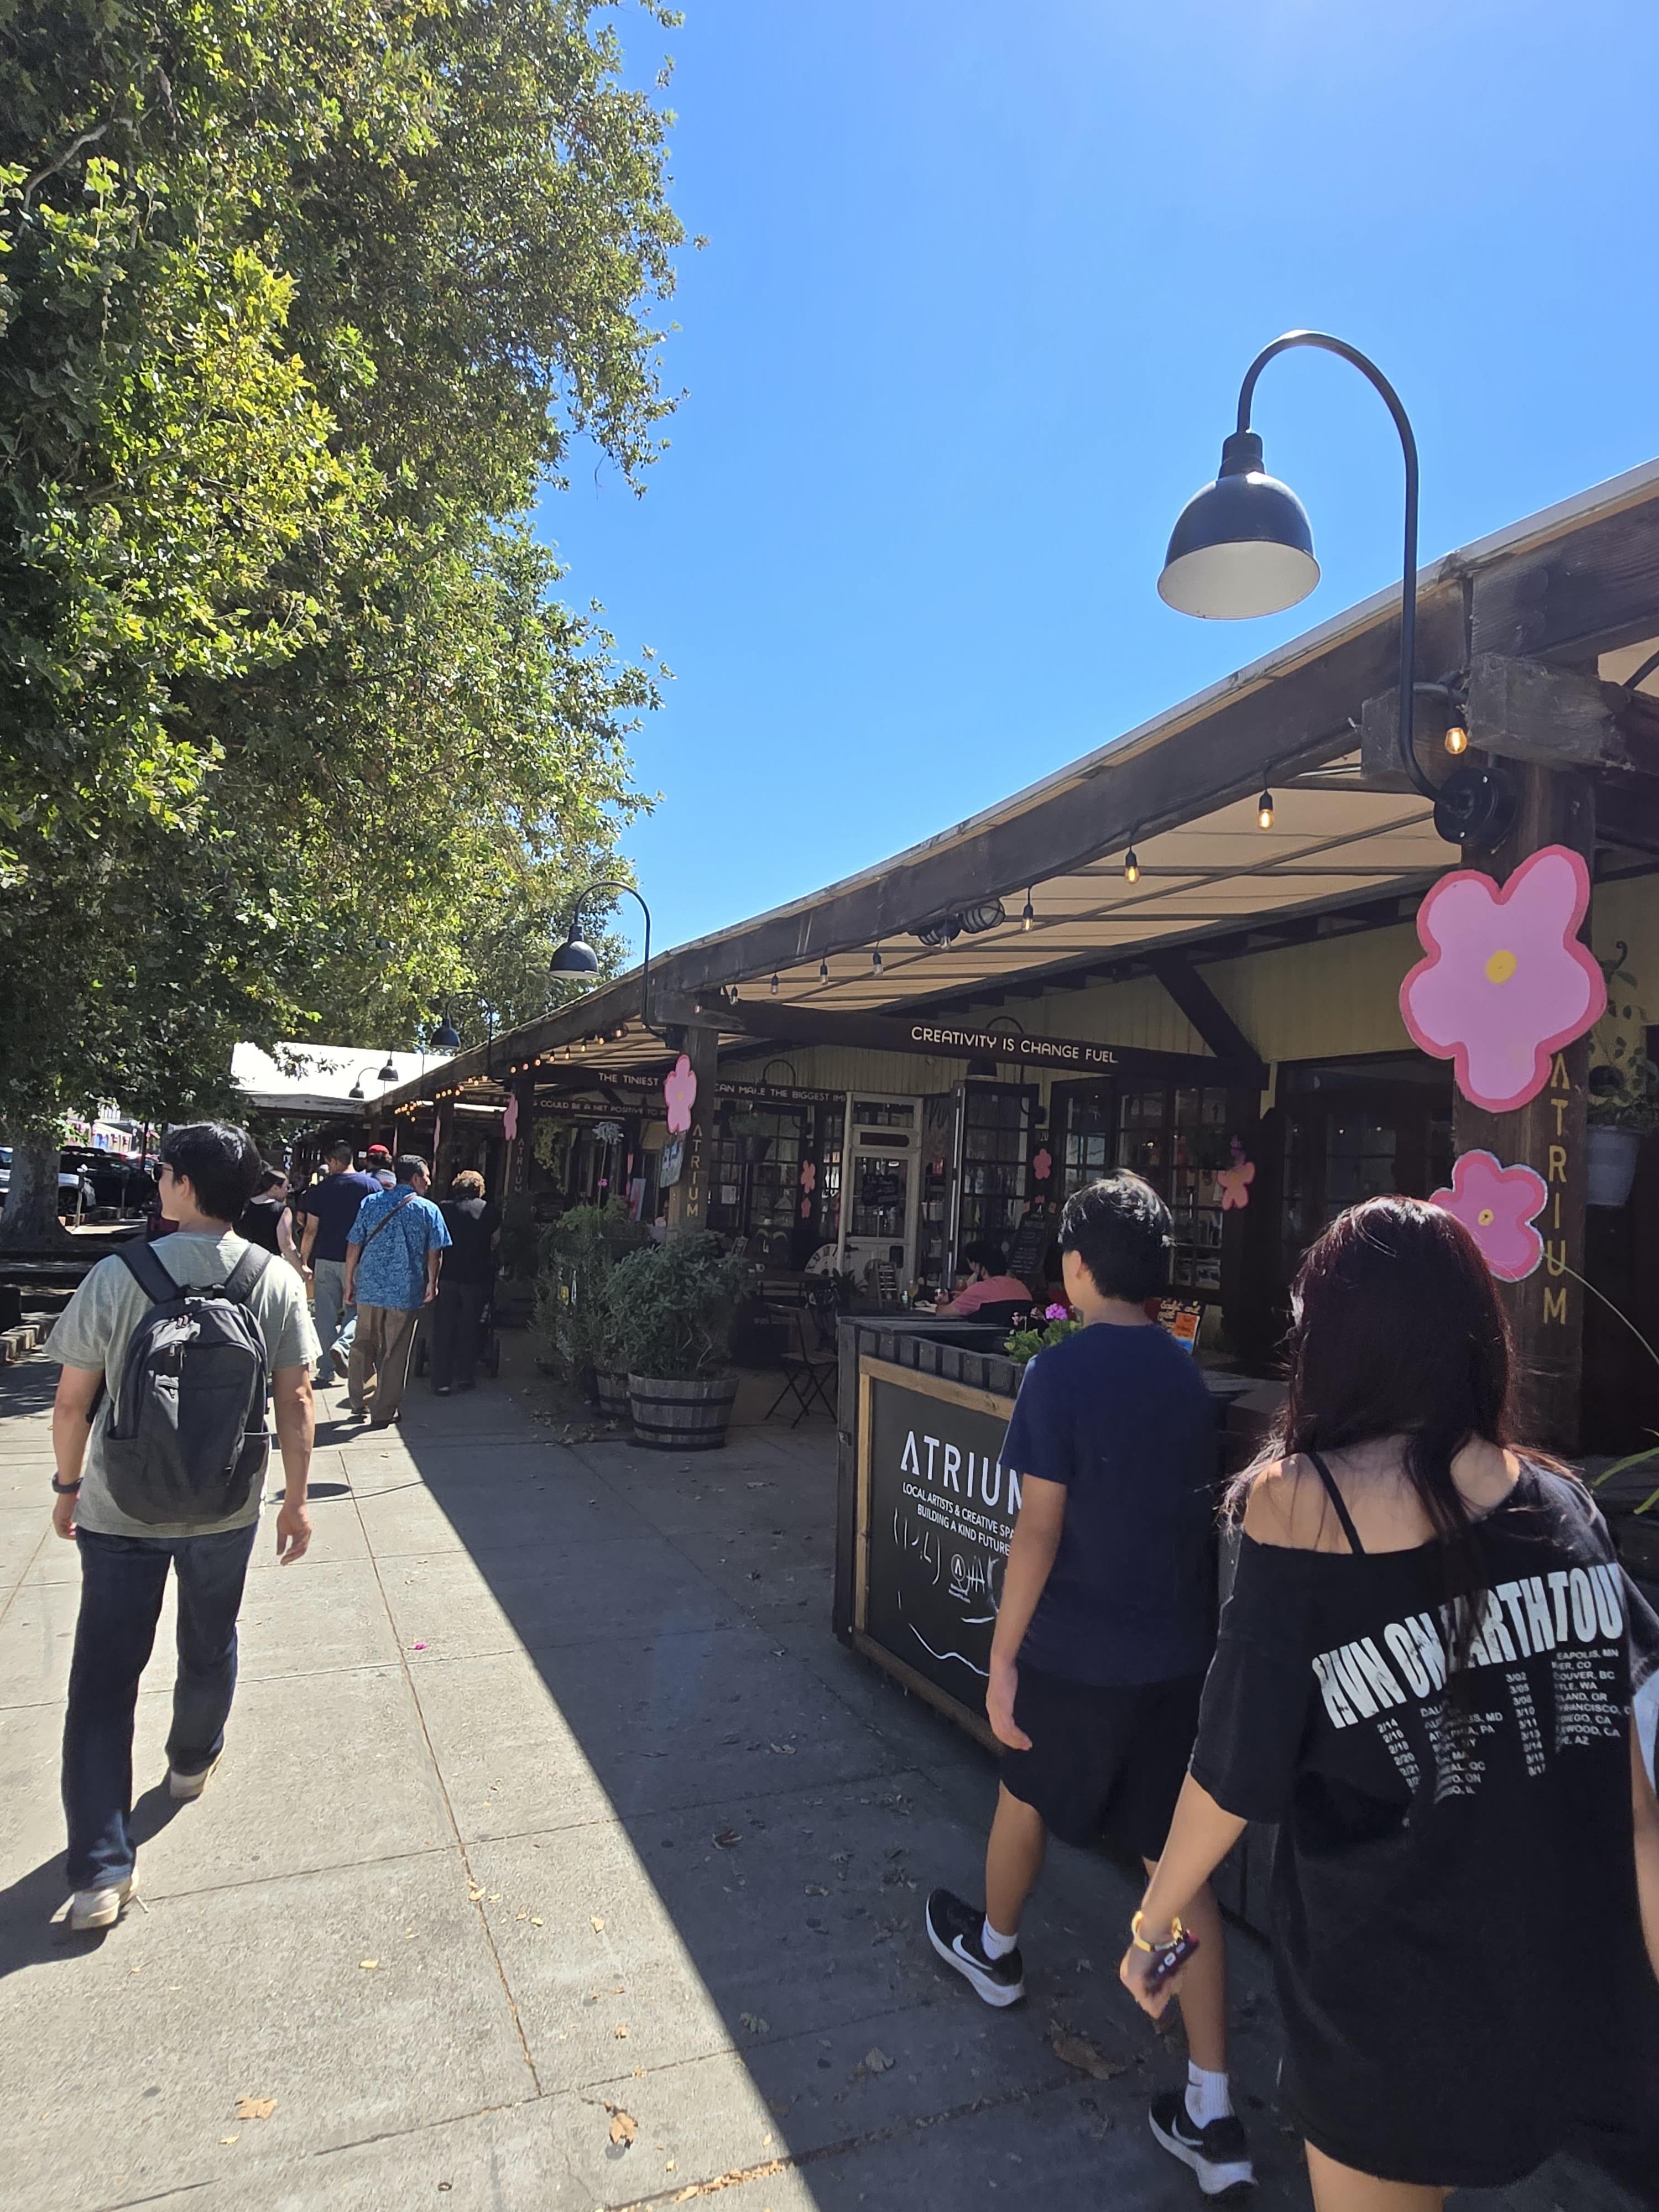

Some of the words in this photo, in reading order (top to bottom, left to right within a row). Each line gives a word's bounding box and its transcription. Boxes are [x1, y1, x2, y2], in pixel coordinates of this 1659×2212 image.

[911, 1026, 997, 1048] CREATIVITY
[1003, 1037, 1015, 1052] IS
[1020, 1040, 1079, 1059] CHANGE
[598, 1072, 618, 1083] THE
[623, 1074, 659, 1087] TINIEST
[770, 1088, 788, 1098] THE
[792, 1091, 830, 1102] BIGGEST
[540, 1100, 569, 1109] COULD
[514, 1138, 525, 1194] ATRIUM
[686, 1124, 703, 1218] ATRIUM
[1543, 1052, 1571, 1326] ATRIUM
[902, 1481, 927, 1501] LOCAL
[927, 1492, 953, 1514] ARTISTS
[954, 1504, 961, 1517] &
[962, 1507, 998, 1535] CREATIVE
[917, 1504, 950, 1528] BUILDING
[950, 1520, 957, 1532] A
[958, 1523, 977, 1542] KIND
[978, 1532, 1011, 1557] FUTURE
[1383, 1612, 1447, 1699] ON
[1577, 1661, 1592, 1669] CO
[1505, 1672, 1527, 1683] 3/02
[1599, 1670, 1615, 1680] BC
[1580, 1682, 1598, 1691] WA
[1591, 1692, 1608, 1702] OR
[1485, 1712, 1504, 1721] MD
[1595, 1715, 1612, 1725] CA
[1376, 1718, 1399, 1734] 2/14
[1480, 1725, 1495, 1734] PA
[1575, 1735, 1590, 1745] AZ
[1394, 1752, 1416, 1766] 2/20
[1469, 1761, 1486, 1771] QC
[1465, 1773, 1481, 1783] ON
